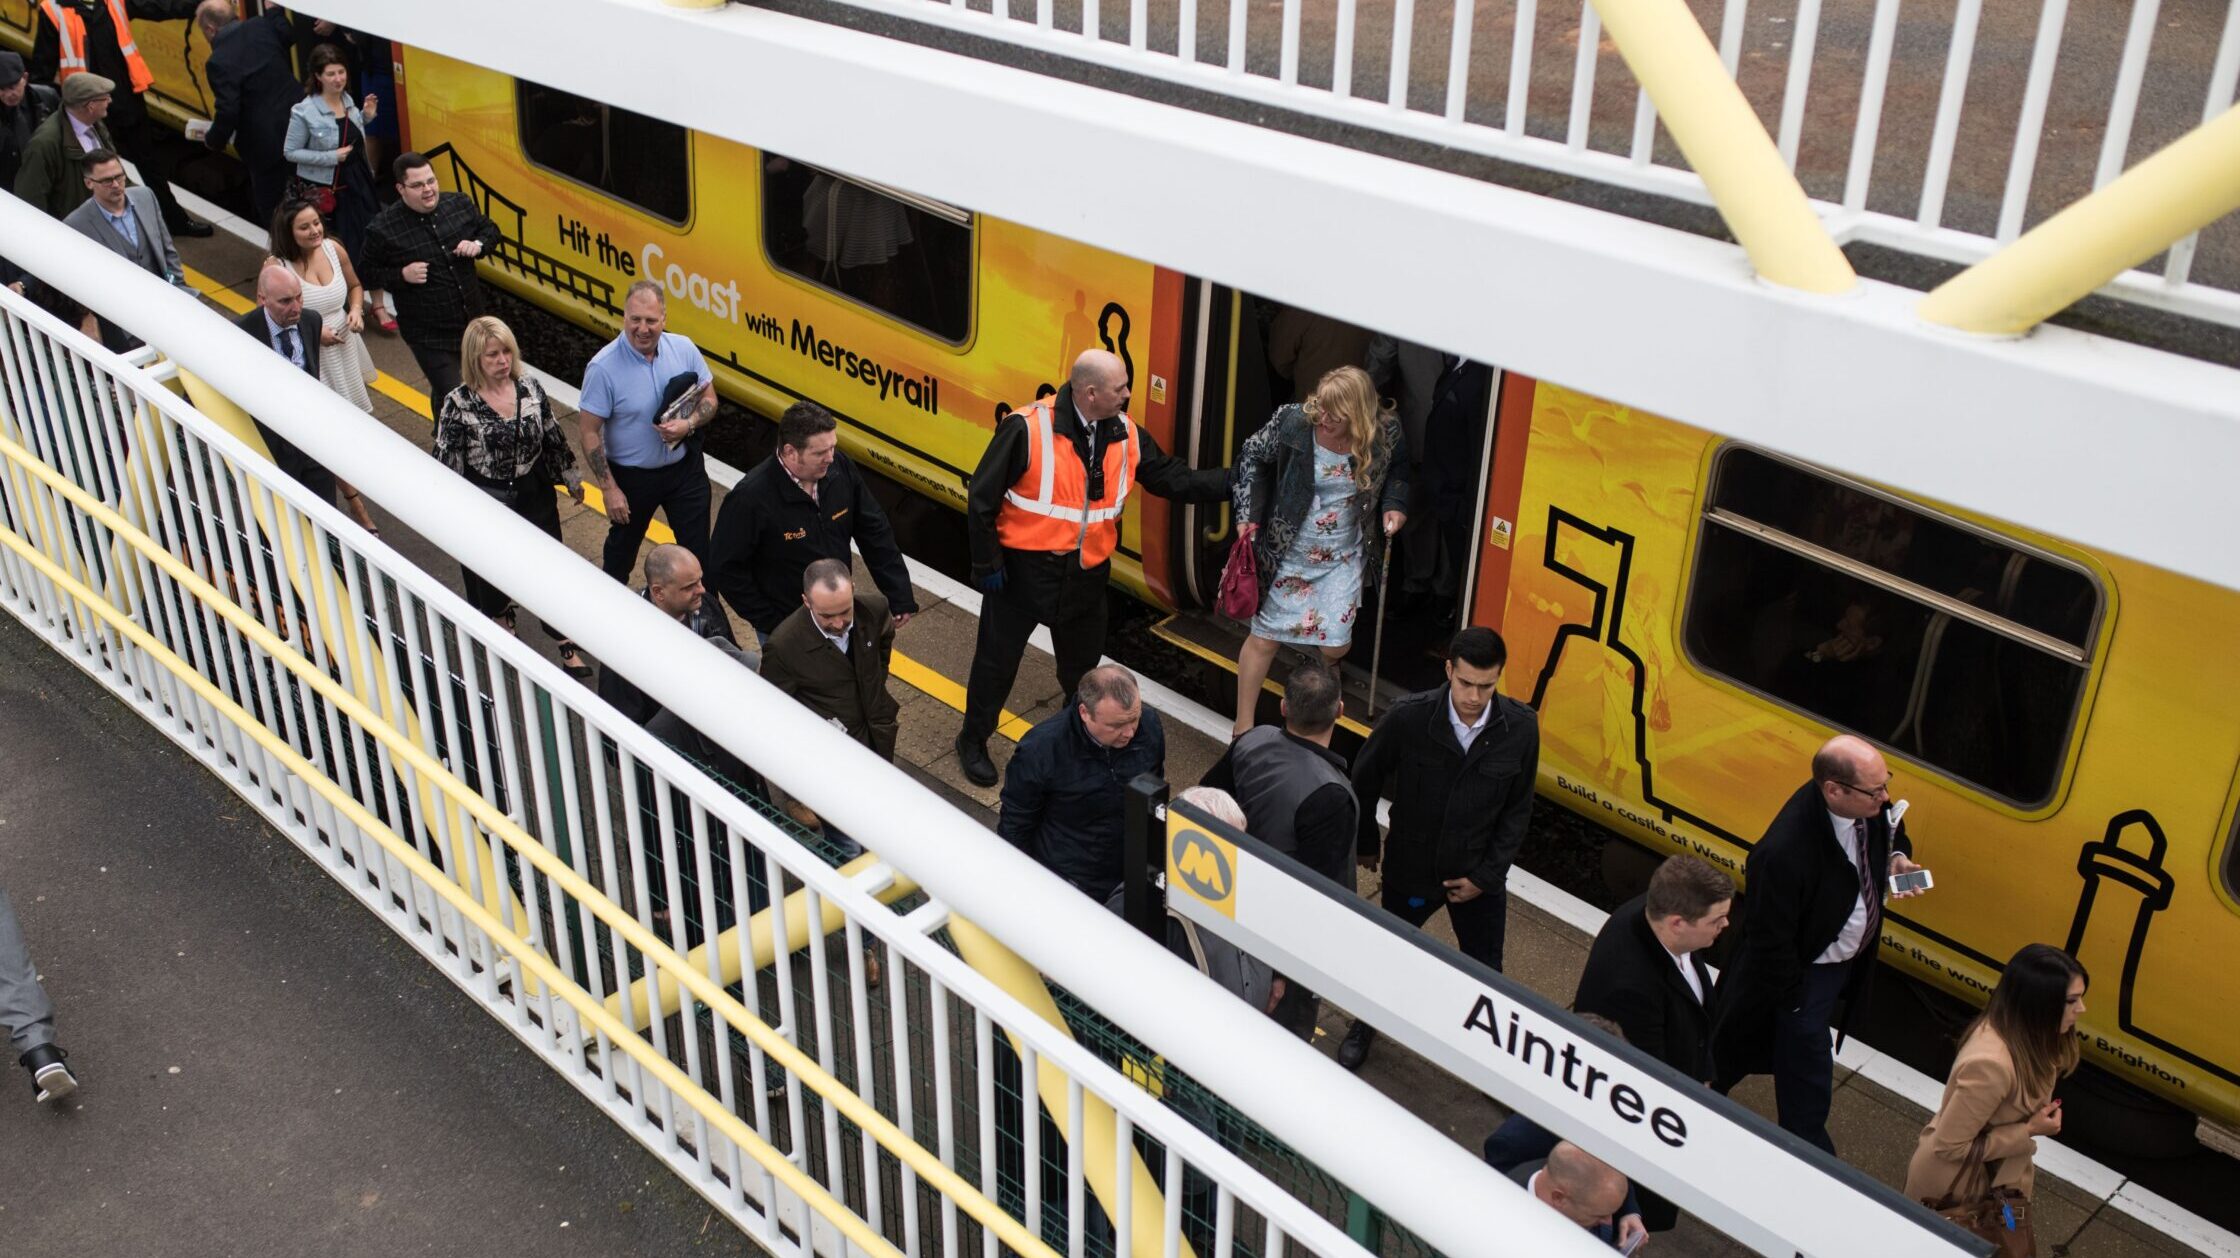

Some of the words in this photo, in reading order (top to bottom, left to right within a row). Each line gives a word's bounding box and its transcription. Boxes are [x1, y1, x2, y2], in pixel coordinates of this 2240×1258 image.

[558, 214, 591, 257] Hit
[596, 232, 636, 276] the
[641, 242, 742, 324] Coast
[745, 312, 785, 346] with
[791, 318, 938, 415] Merseyrail
[1557, 775, 1598, 804] Build
[1602, 799, 1613, 812] a
[1618, 807, 1667, 837] castle
[1671, 831, 1689, 847] at
[1692, 840, 1736, 870] West
[1910, 947, 1941, 970] the
[1462, 994, 1688, 1148] Aintree
[2096, 1037, 2187, 1089] Brighton
